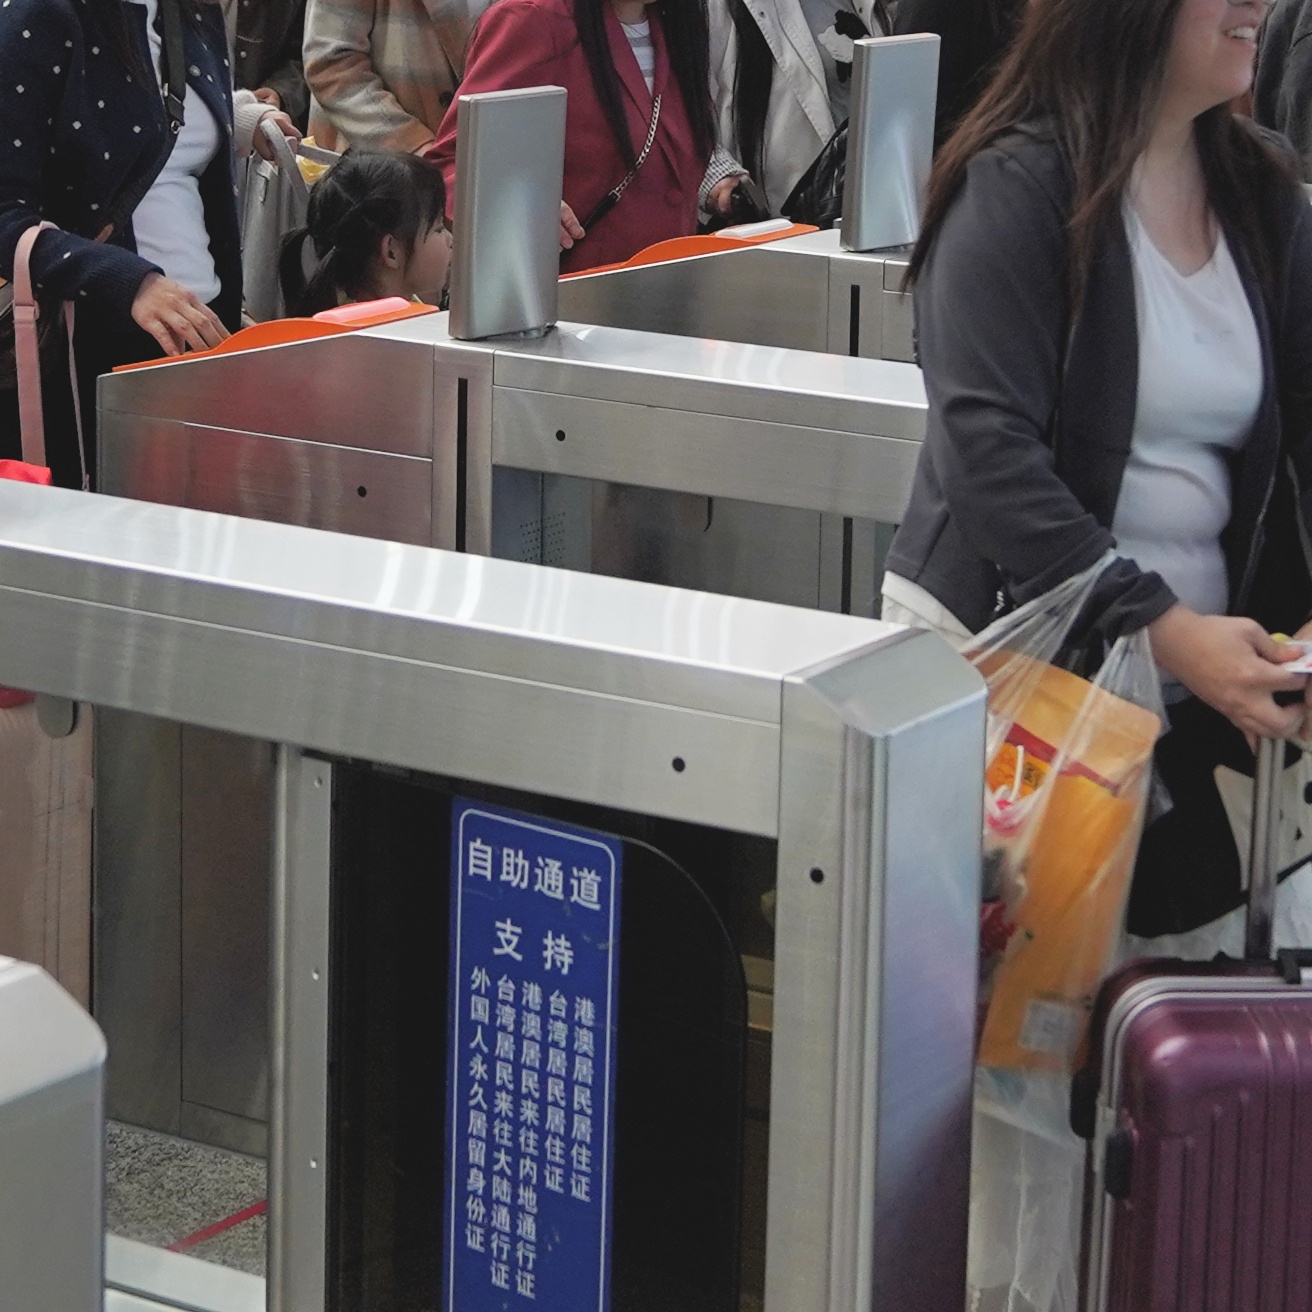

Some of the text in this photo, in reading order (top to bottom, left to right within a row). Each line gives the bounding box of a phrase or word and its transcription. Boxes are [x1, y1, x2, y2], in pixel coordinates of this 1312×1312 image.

[467, 837, 602, 911] 自助通道
[493, 918, 575, 976] 支持
[464, 966, 491, 1254] 外国人永久居留身份证
[490, 973, 517, 1290] 台湾居民来往大陆通行证
[515, 979, 543, 1300] 港澳居民来往内地通行证
[544, 988, 569, 1194] 台湾居民居住证
[571, 995, 595, 1203] 港澳居民居住证
